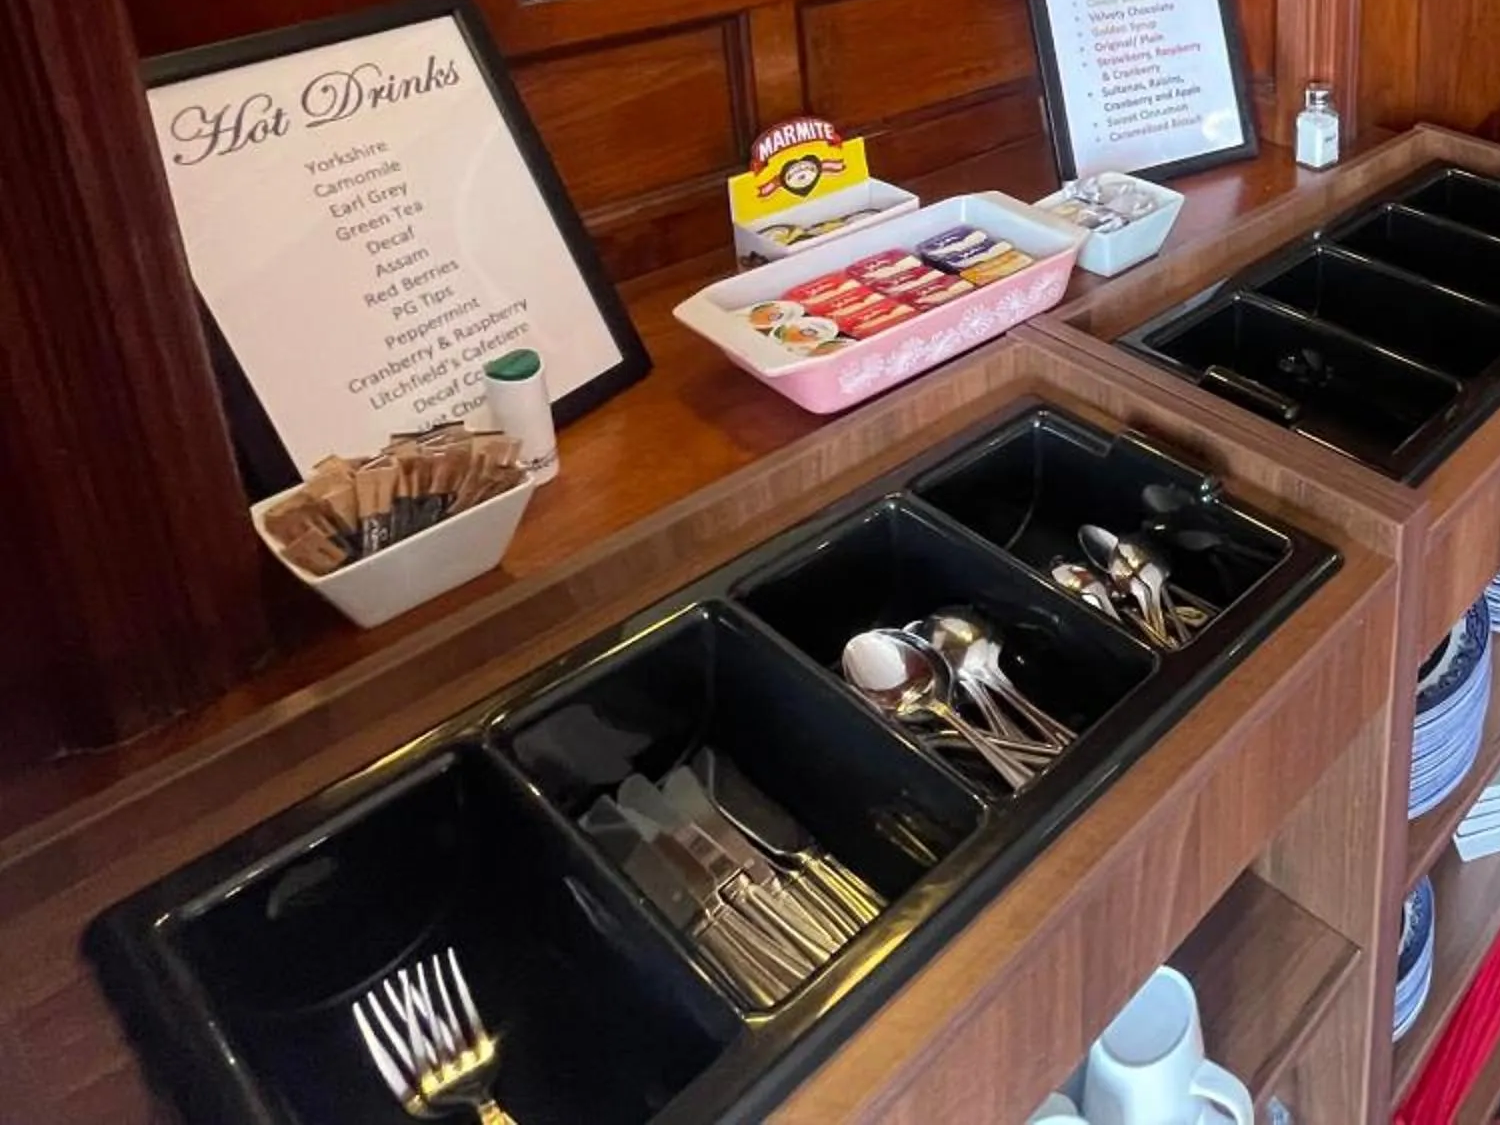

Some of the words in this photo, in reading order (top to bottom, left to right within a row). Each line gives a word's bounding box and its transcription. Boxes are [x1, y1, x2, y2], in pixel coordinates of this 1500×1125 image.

[1112, 64, 1160, 80] Cranberry
[171, 93, 290, 165] Hot
[301, 55, 459, 128] Drinks
[1103, 95, 1153, 112] Cranberry
[304, 141, 388, 175] Yorkshire
[759, 122, 835, 162] MARMITE
[314, 161, 401, 197] Camomile
[329, 194, 365, 218] Earl
[367, 182, 407, 204] Grey
[336, 214, 390, 241] Green
[392, 201, 423, 219] Tea
[366, 224, 415, 255] Decaf
[376, 248, 429, 277] Assam
[364, 284, 399, 307] Red
[401, 260, 459, 291] Berries
[392, 301, 418, 320] PG
[420, 286, 454, 308] Tips
[384, 298, 480, 349] Peppermint
[349, 345, 433, 394] Cranberry
[437, 336, 452, 350] &
[454, 298, 527, 341] Raspberry
[370, 356, 461, 410] Litchfield's
[462, 322, 530, 362] Cafetiere
[413, 379, 460, 414] Decaf
